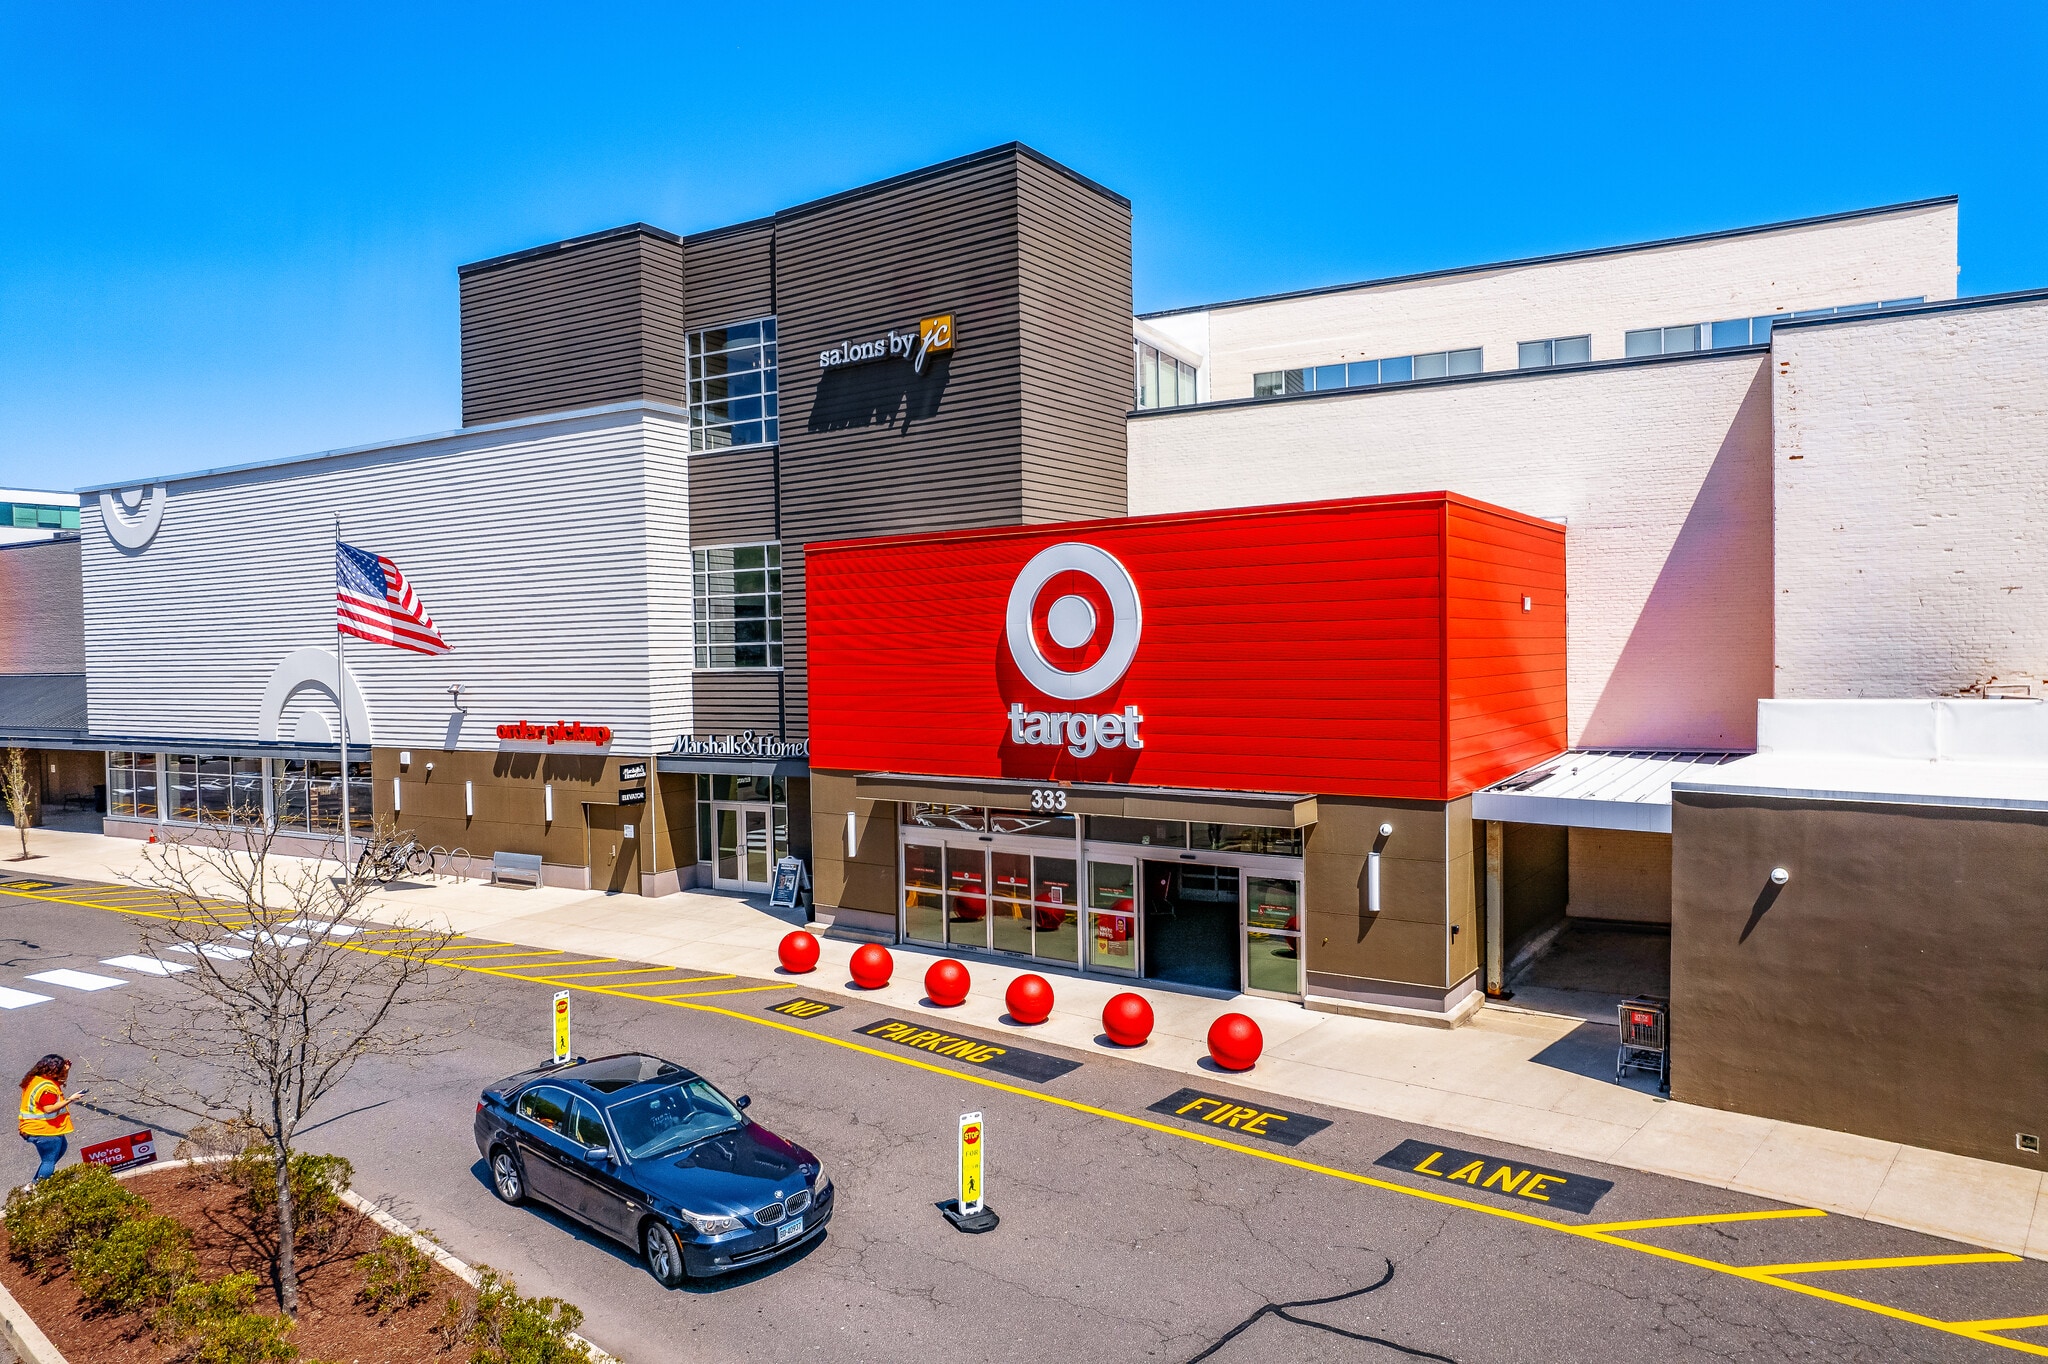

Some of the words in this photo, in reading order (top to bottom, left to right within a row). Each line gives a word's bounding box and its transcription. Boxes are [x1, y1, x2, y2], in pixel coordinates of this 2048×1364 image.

[819, 341, 886, 368] salons
[888, 330, 919, 359] by
[496, 720, 546, 741] order
[546, 720, 611, 746] pickup
[1007, 702, 1144, 758] target
[1031, 789, 1067, 810] 333
[776, 1000, 830, 1017] NO
[867, 1022, 1007, 1063] PARKING
[1175, 1097, 1288, 1135] FIRE
[1412, 1151, 1567, 1201] LANE
[964, 1131, 980, 1141] STOP
[89, 1147, 121, 1160] We're
[965, 1149, 979, 1157] FOR
